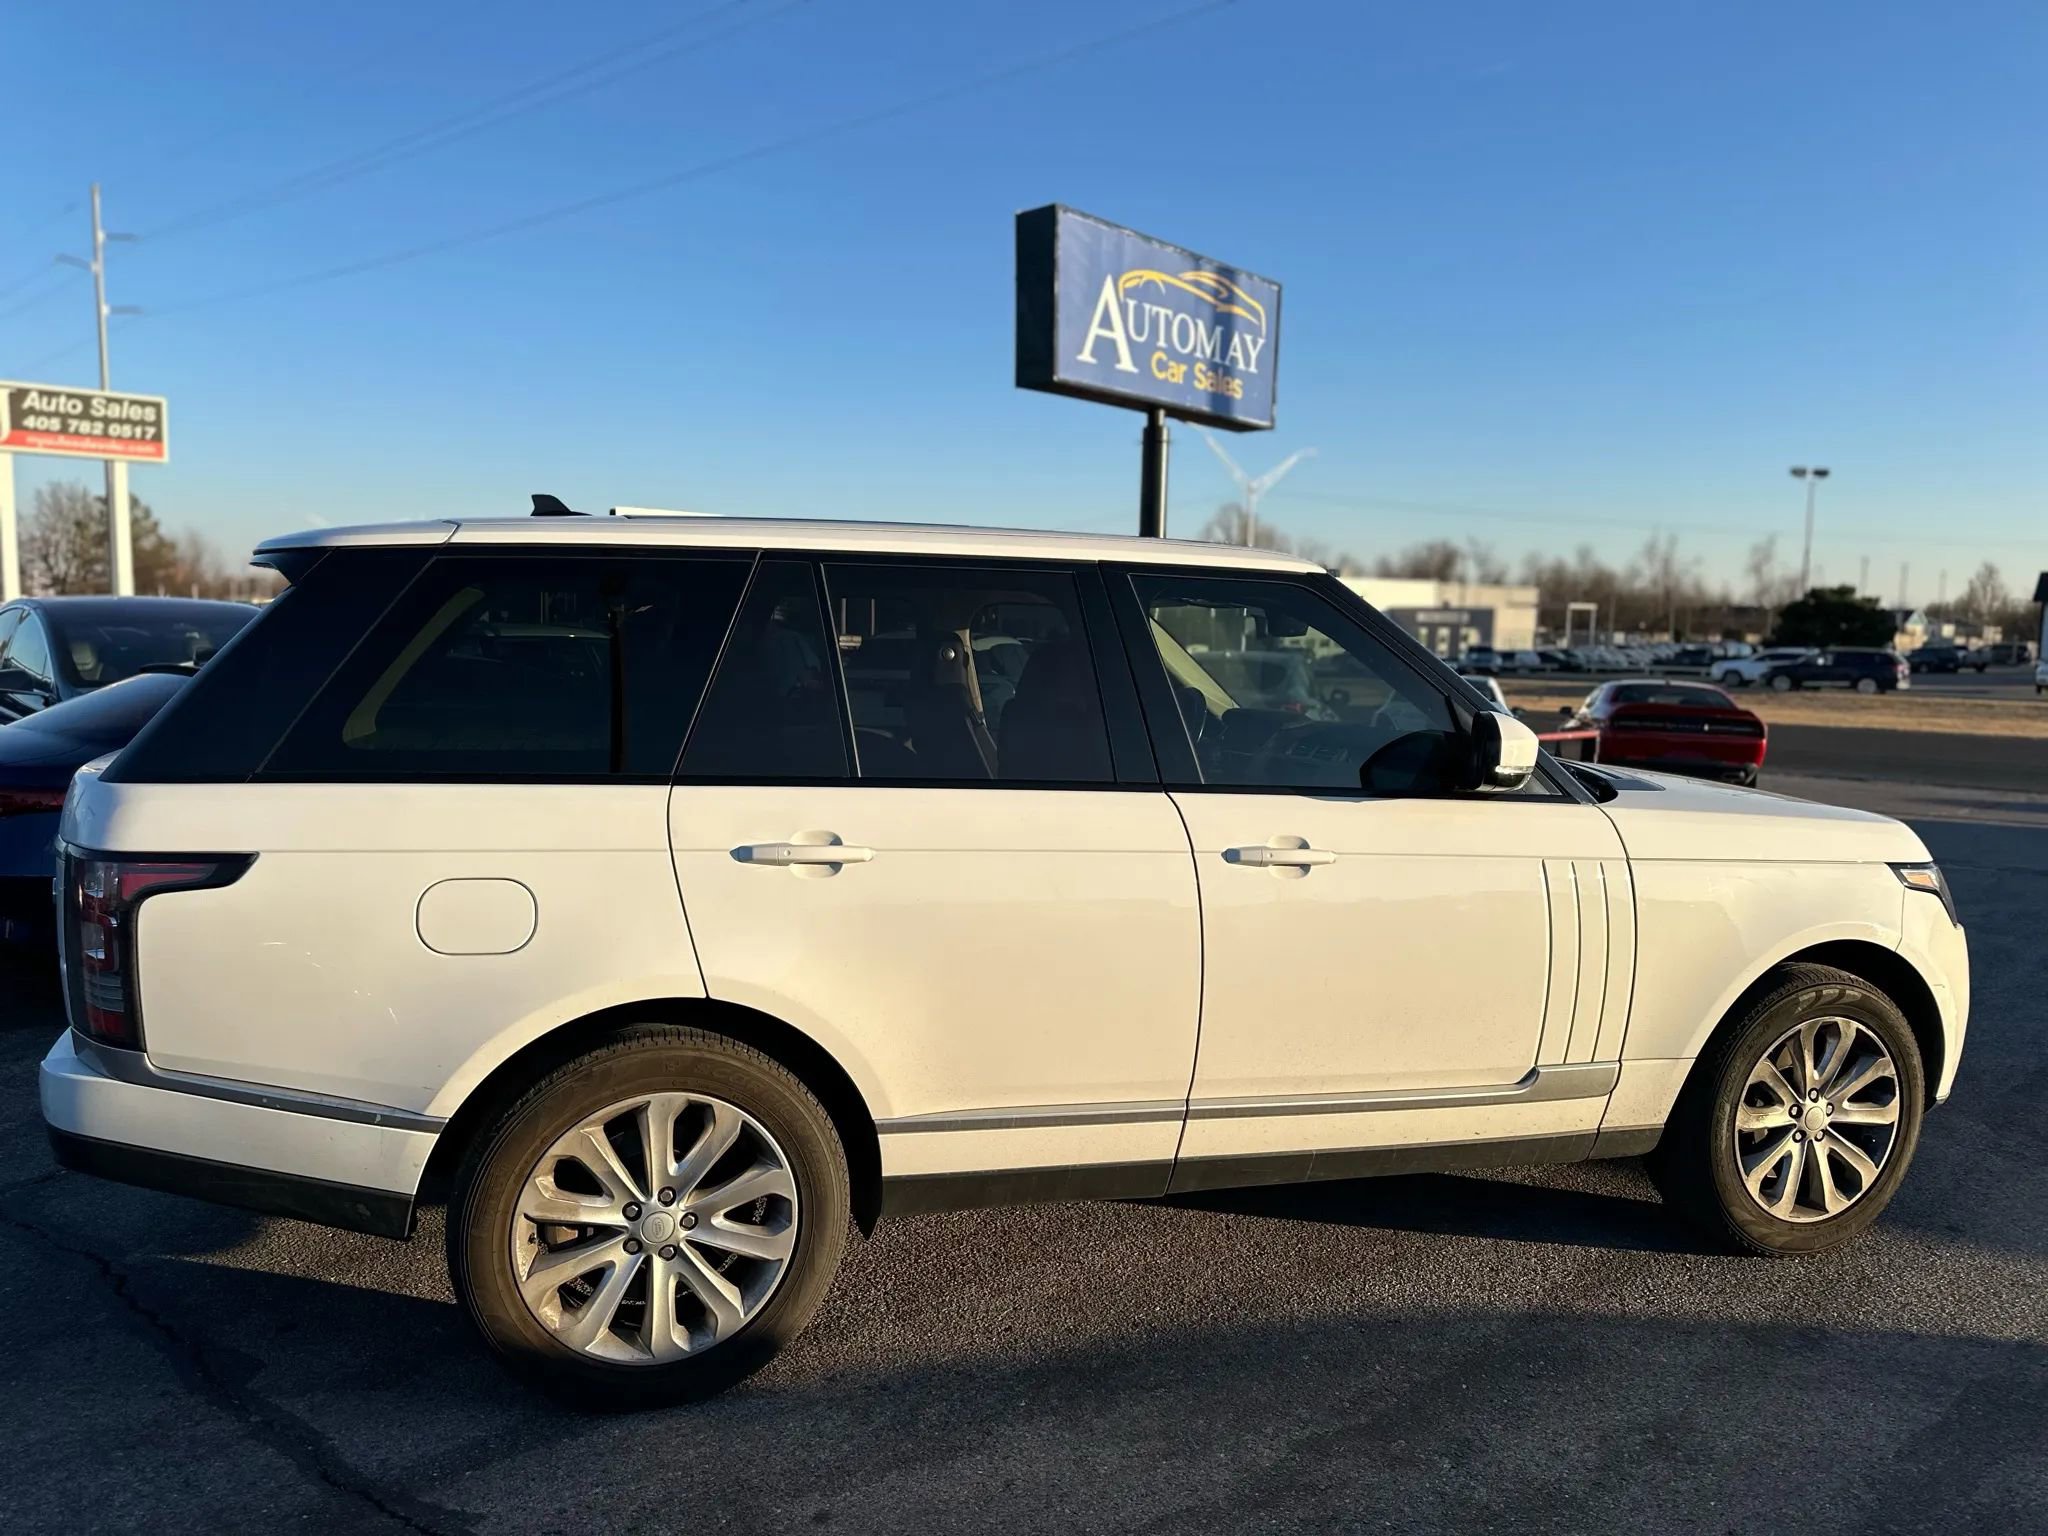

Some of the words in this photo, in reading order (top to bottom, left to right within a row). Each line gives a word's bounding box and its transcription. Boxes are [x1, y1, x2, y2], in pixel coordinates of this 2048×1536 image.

[1076, 273, 1267, 374] AUTOMAY
[1151, 351, 1188, 385] Car
[1194, 362, 1243, 399] Sales
[22, 390, 83, 415] Auto
[90, 397, 157, 423] Sales
[22, 415, 61, 431] 405
[108, 423, 157, 440] 0517
